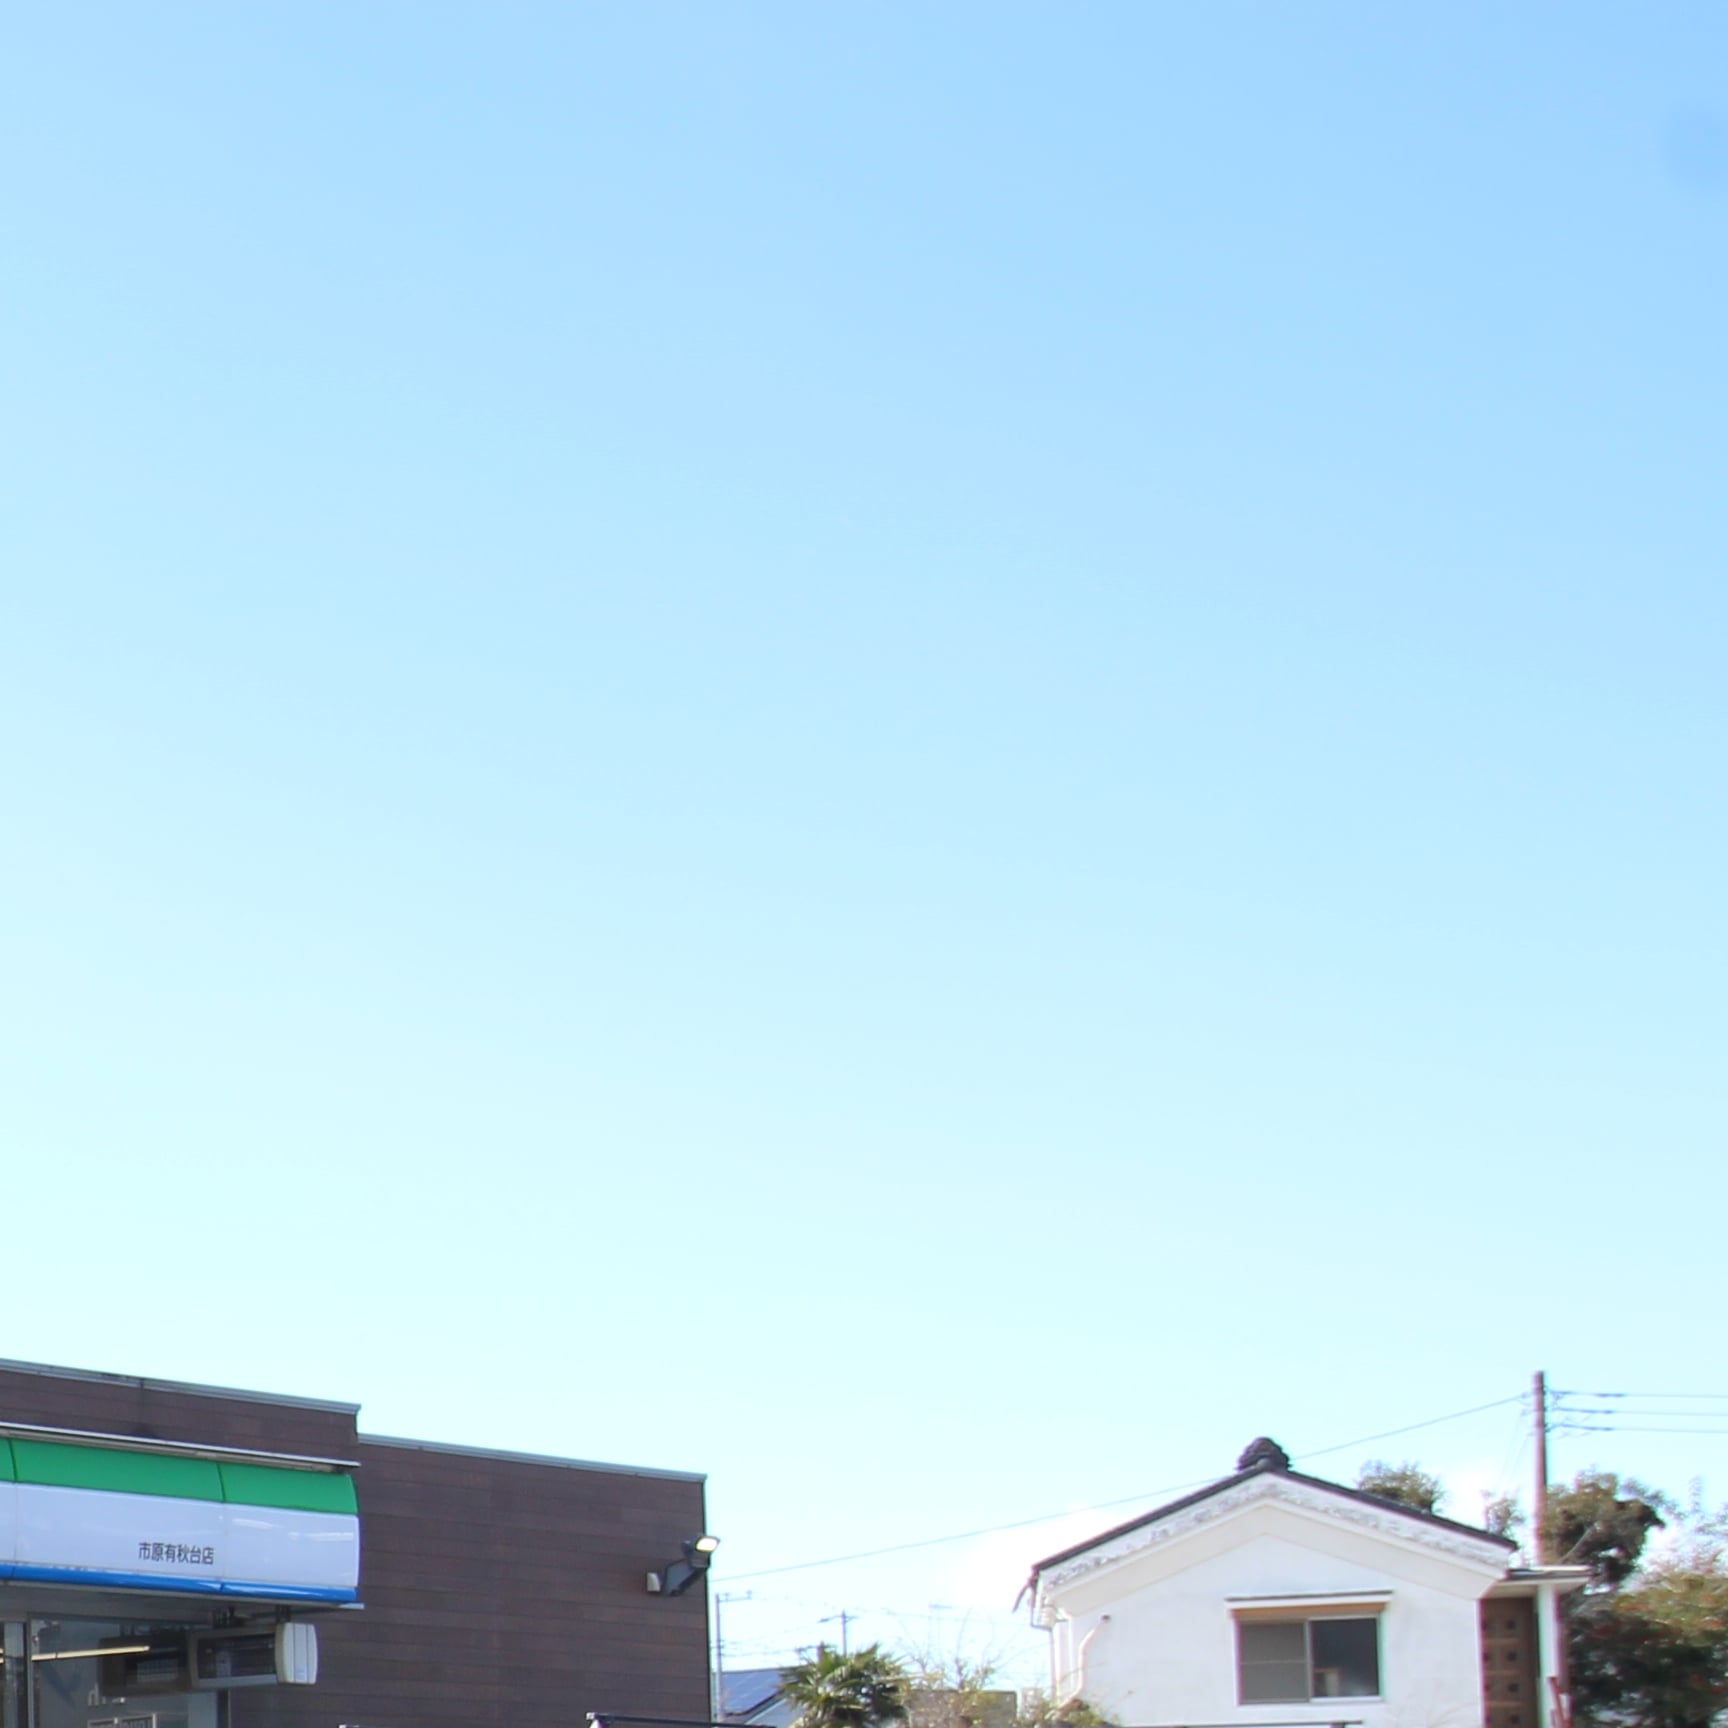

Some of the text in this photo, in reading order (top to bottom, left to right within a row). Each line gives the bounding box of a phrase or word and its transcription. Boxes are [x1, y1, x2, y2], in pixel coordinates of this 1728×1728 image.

[138, 1541, 215, 1565] 市原有秋台店
